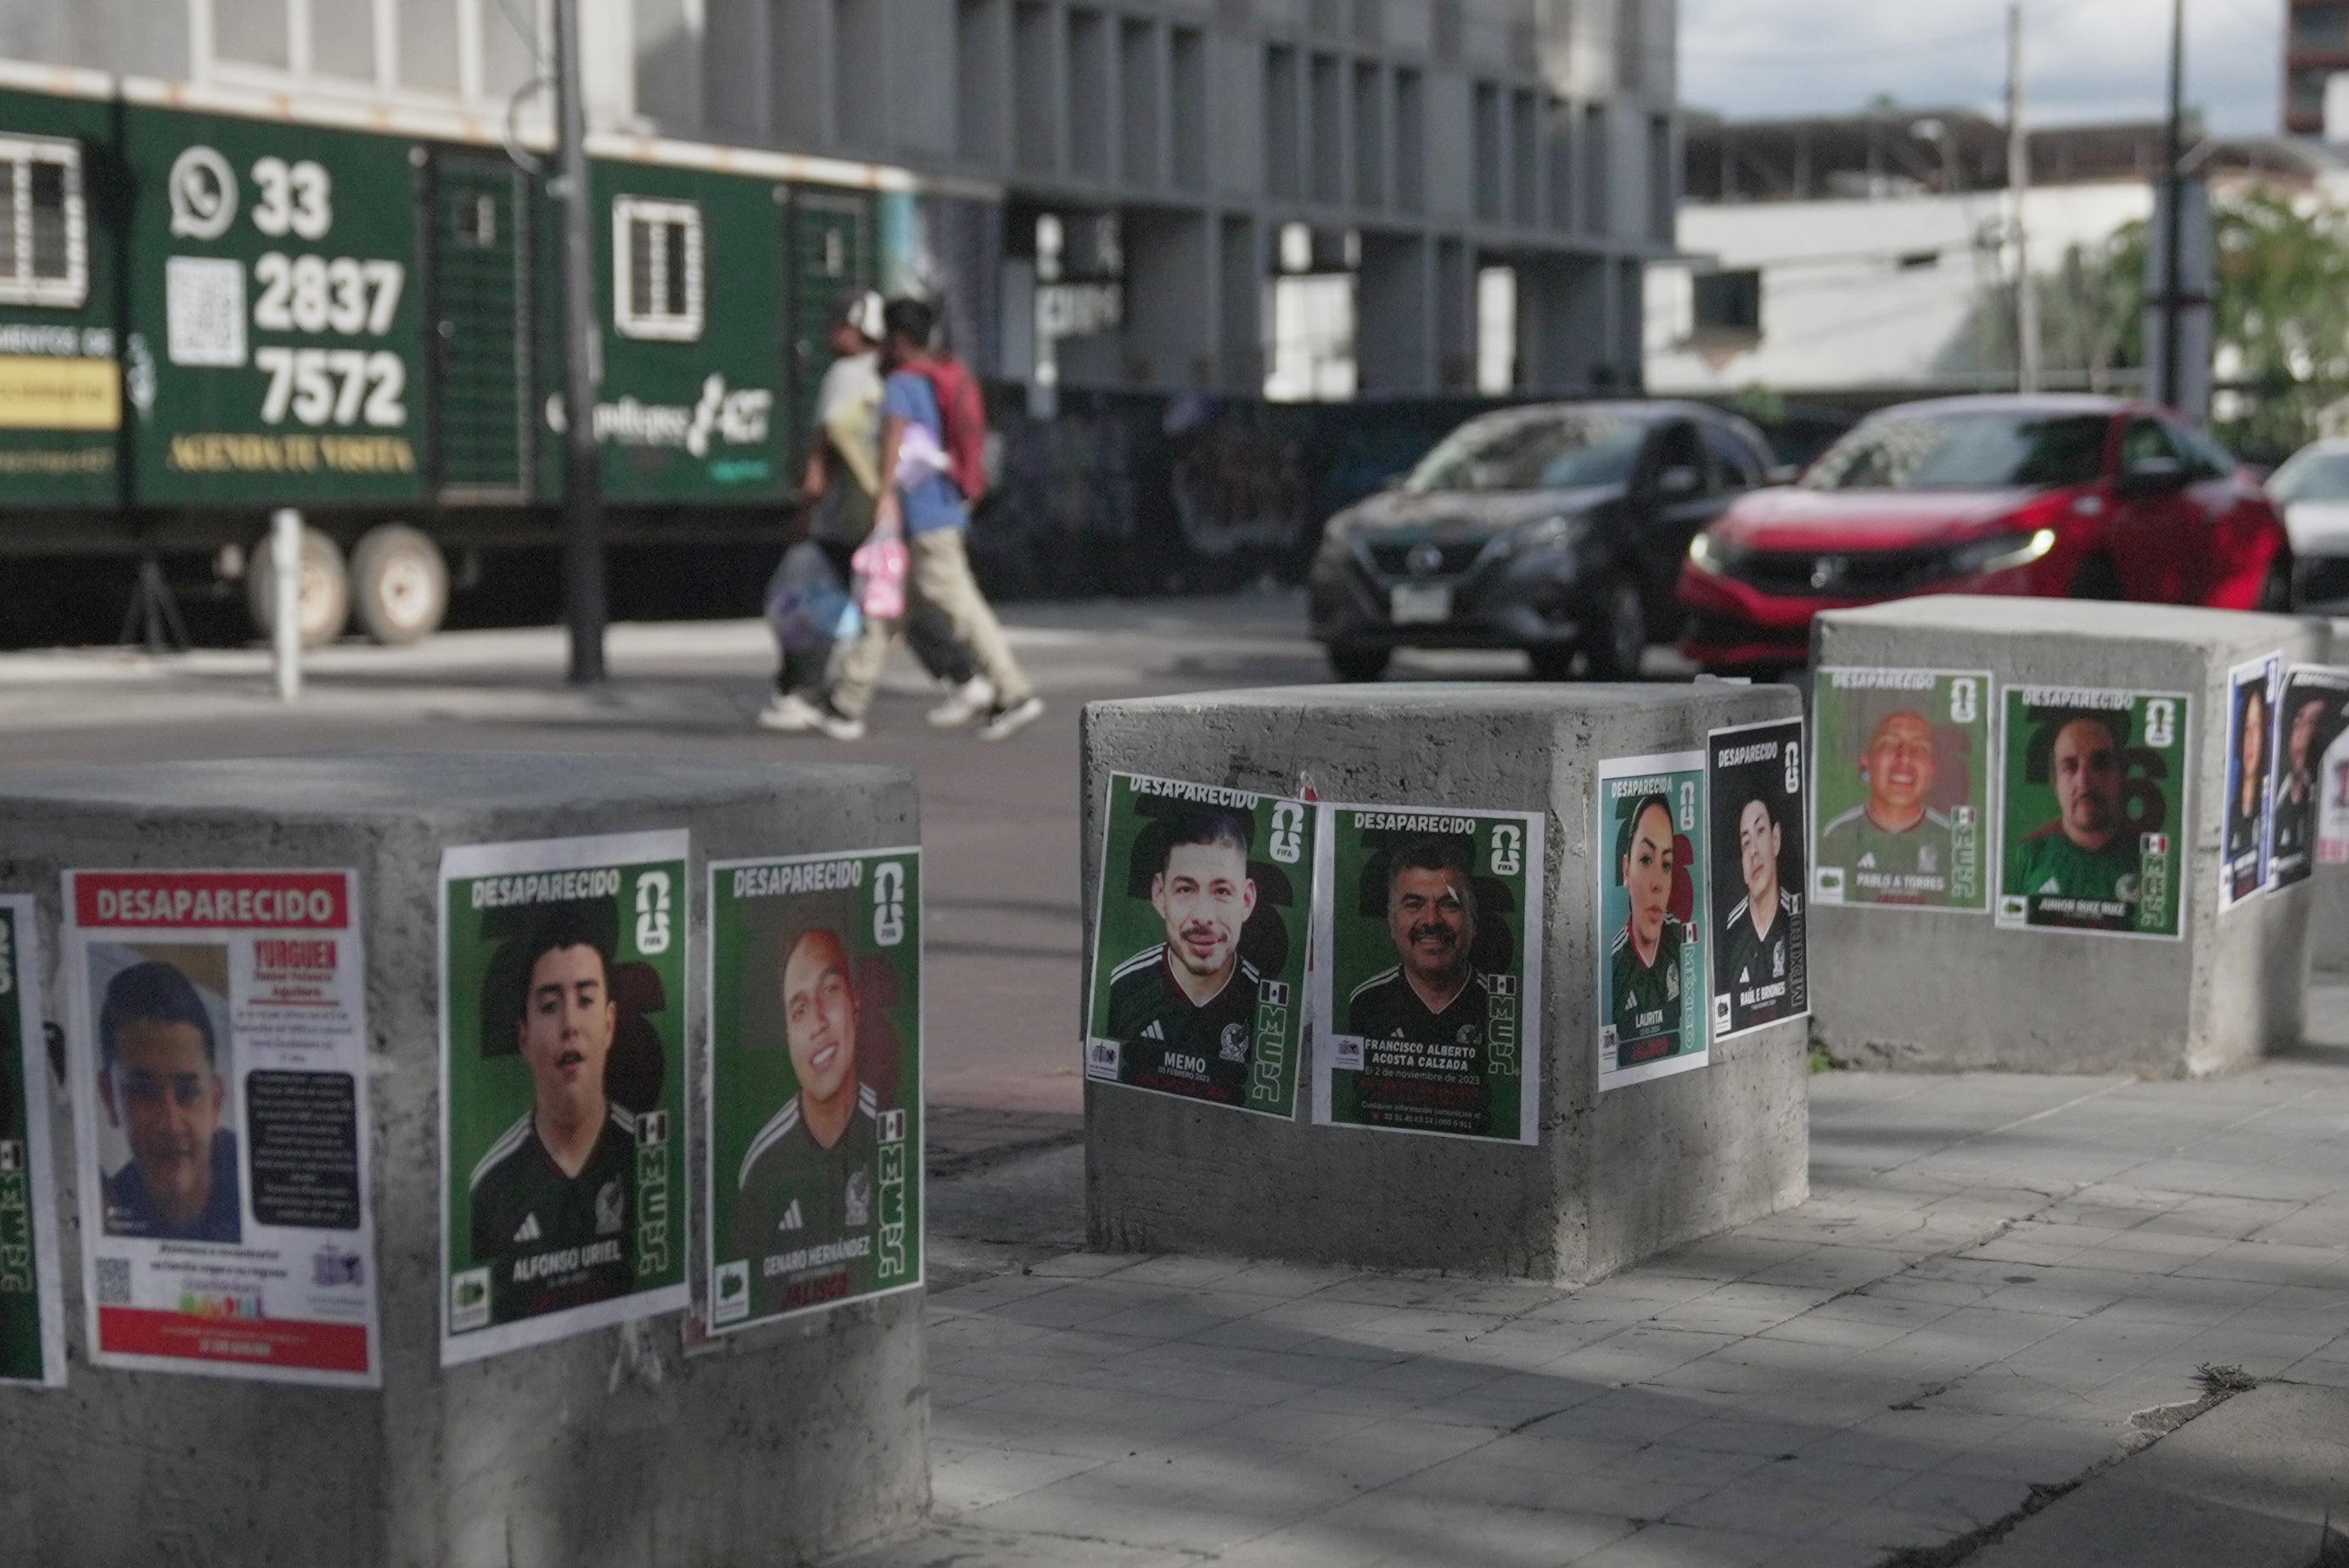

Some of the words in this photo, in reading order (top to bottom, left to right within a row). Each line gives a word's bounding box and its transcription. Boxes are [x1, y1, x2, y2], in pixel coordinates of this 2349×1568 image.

[252, 155, 332, 238] 33
[255, 252, 405, 335] 2837
[255, 346, 406, 426] 7572
[1832, 672, 1936, 690] DESAPARECIDO
[2021, 689, 2135, 710] DESAPARECIDO
[1718, 742, 1777, 768] DESAPARECIDO
[1130, 776, 1259, 810] DESAPARECIDO
[1612, 776, 1673, 798] DESAPARECIDA
[1354, 813, 1476, 835] DESAPARECIDO
[1276, 848, 1292, 857] FIFA
[471, 869, 621, 909] DESAPARECIDO
[733, 860, 862, 898] DESAPARECIDO
[1903, 875, 1945, 890] TORRES
[97, 888, 334, 922] DESAPARECIDO
[1636, 1010, 1662, 1028] LAURITA
[1365, 1039, 1423, 1054] FRANCISCO
[1427, 1044, 1476, 1058] ALBERTO
[1164, 1051, 1207, 1073] MEMO
[1372, 1053, 1415, 1067] ACOSTA
[1418, 1057, 1468, 1071] CALZADA
[1382, 1067, 1393, 1077] de
[1396, 1069, 1443, 1082] noviembre
[1444, 1073, 1456, 1082] de
[1458, 1075, 1480, 1085] 2023
[513, 1247, 580, 1282] ALFONSO
[581, 1239, 621, 1266] URIEL
[764, 1249, 806, 1277] GENARO
[808, 1235, 871, 1268] HERNÁNDEZ
